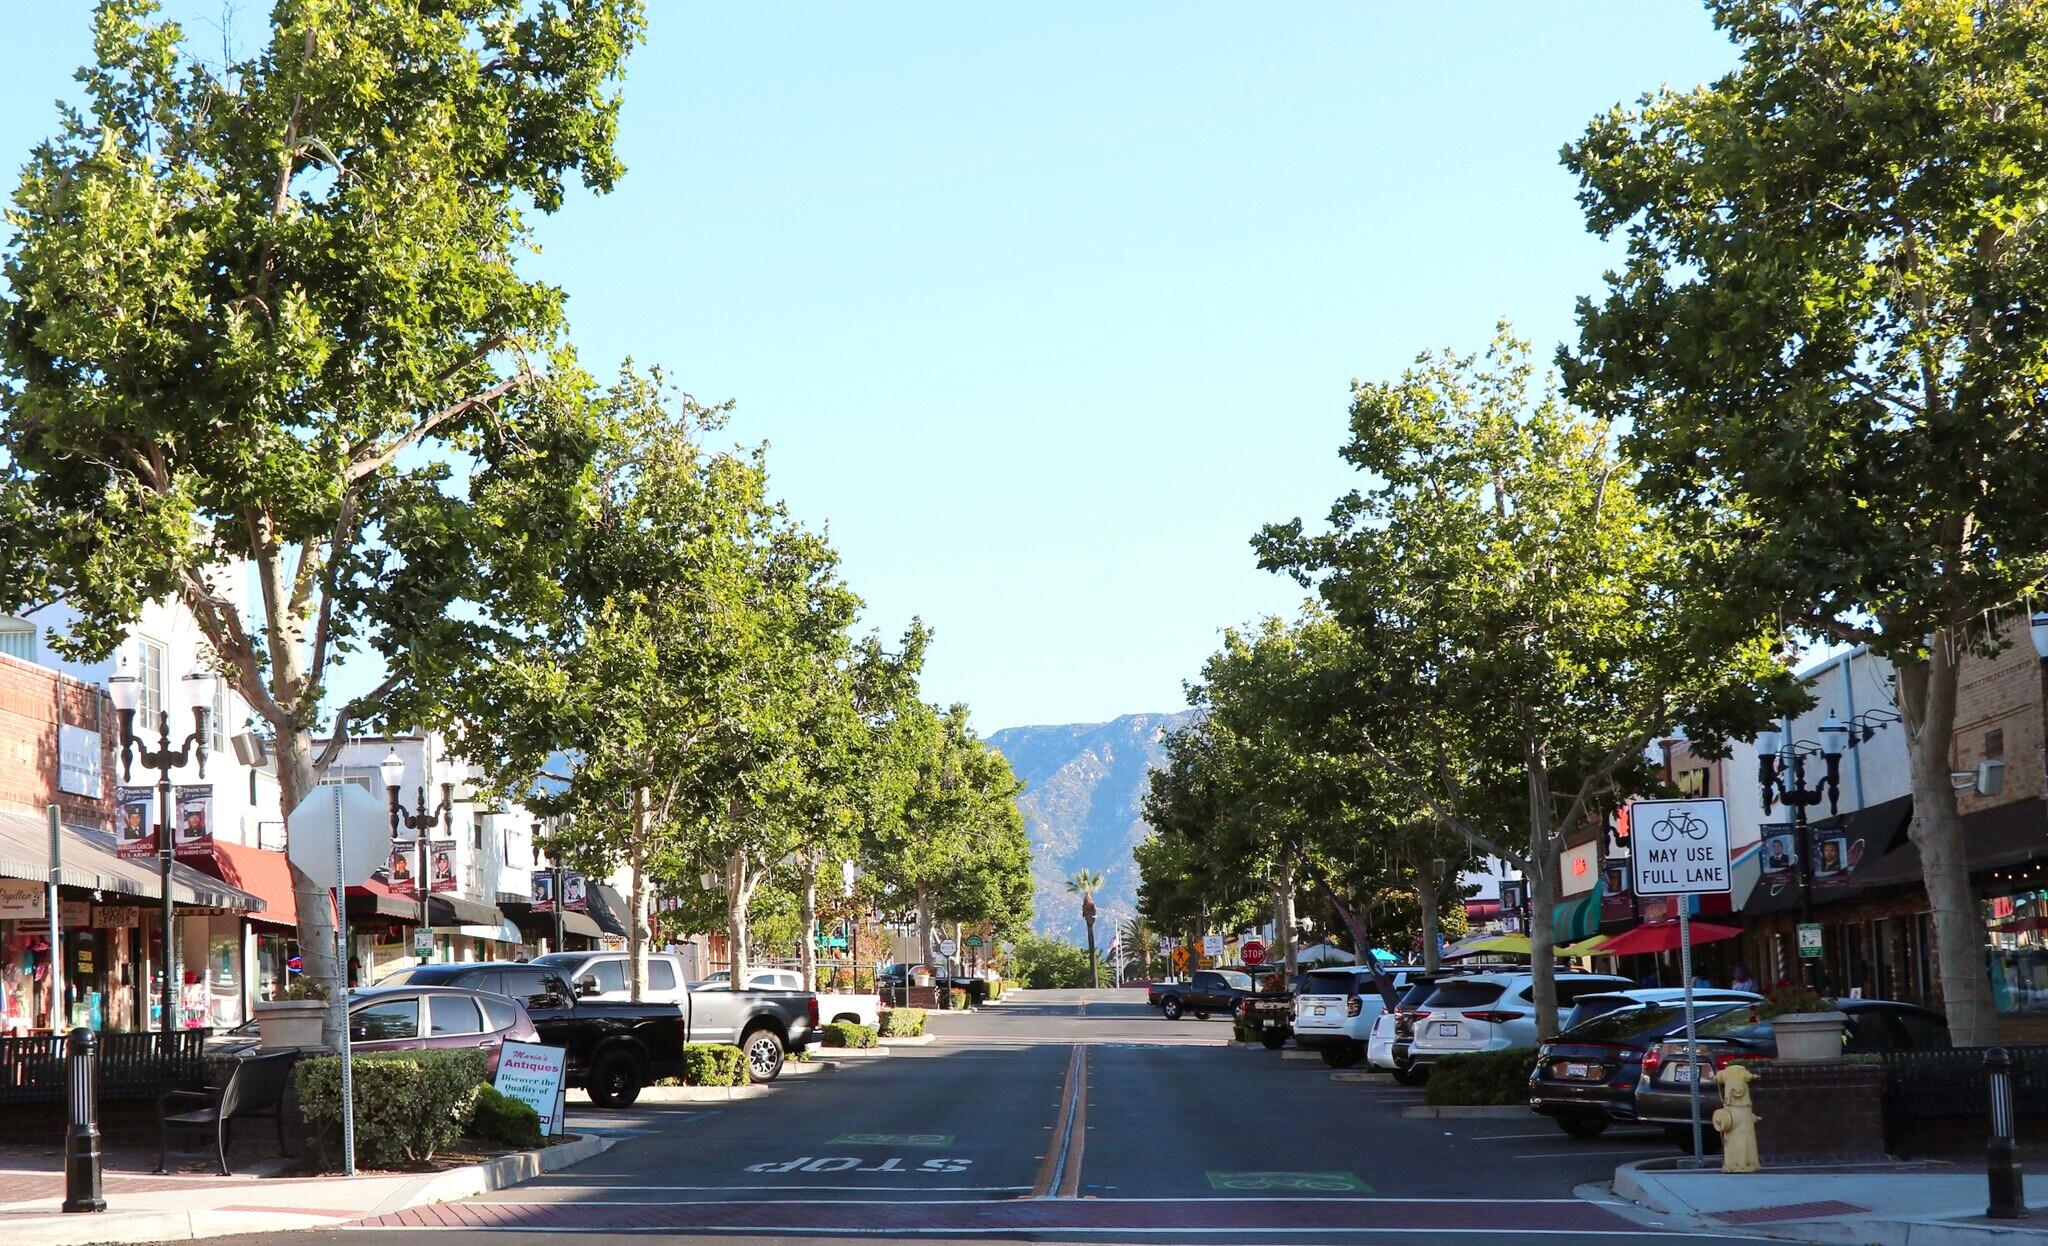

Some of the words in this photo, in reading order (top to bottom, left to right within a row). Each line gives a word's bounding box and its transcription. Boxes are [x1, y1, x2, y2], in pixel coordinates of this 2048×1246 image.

[1649, 848, 1678, 863] MAY
[1686, 846, 1714, 861] USE
[1643, 869, 1679, 884] FULL
[1686, 867, 1723, 882] LANE
[1242, 950, 1264, 958] STOP
[512, 1050, 548, 1061] Maria's
[504, 1059, 559, 1073] Antiques
[501, 1073, 540, 1085] Discover
[541, 1078, 556, 1087] the
[504, 1083, 536, 1095] Quality
[539, 1087, 549, 1095] of
[743, 1157, 973, 1173] STOP
